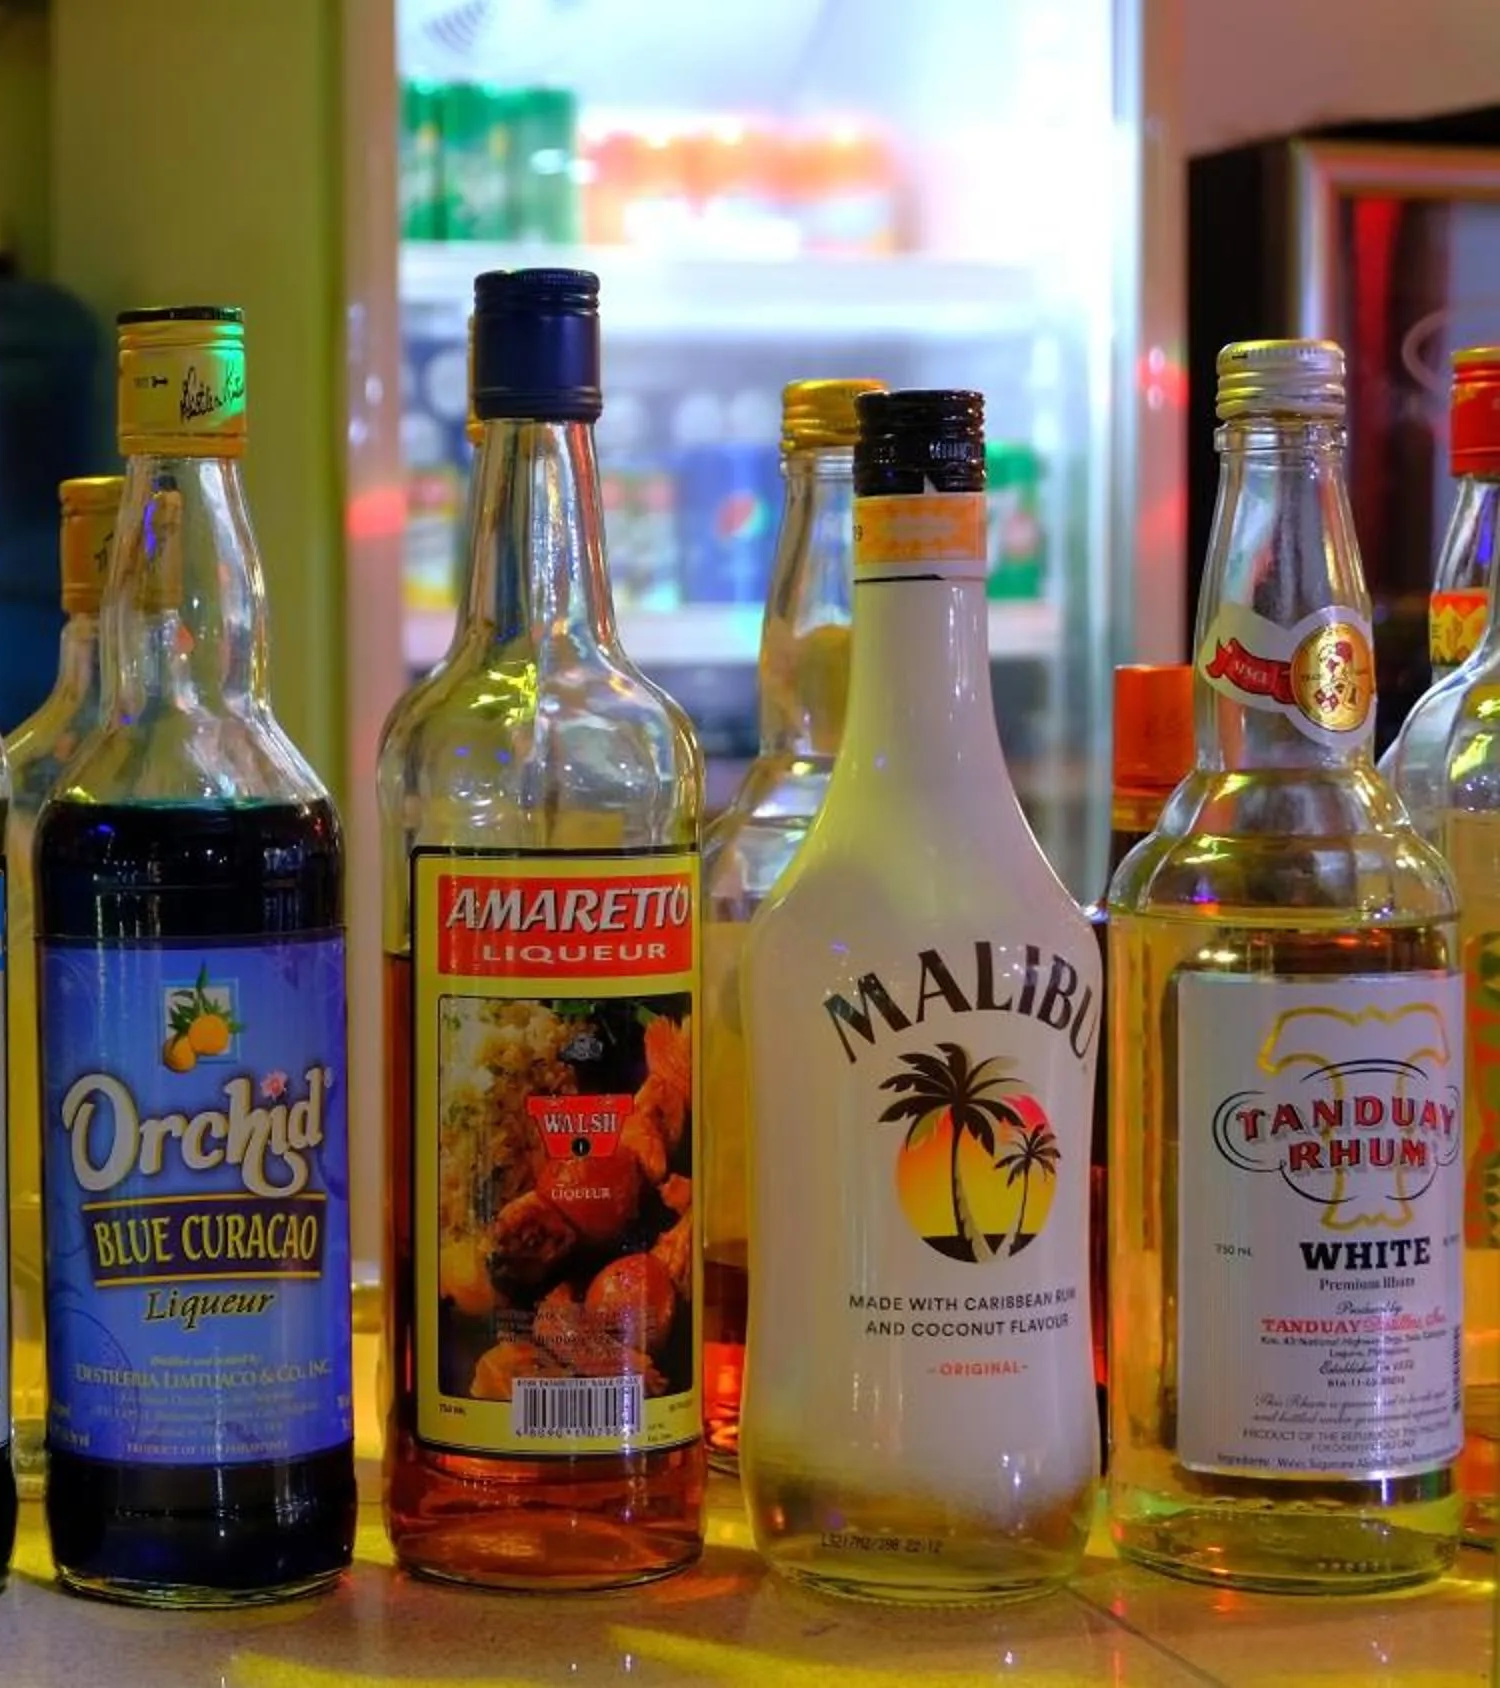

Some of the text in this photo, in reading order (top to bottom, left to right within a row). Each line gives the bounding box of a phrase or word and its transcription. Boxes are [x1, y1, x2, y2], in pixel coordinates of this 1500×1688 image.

[445, 883, 690, 934] AMARETTO
[482, 943, 668, 965] LIQUEUR
[61, 1066, 324, 1199] Orchid
[542, 1112, 618, 1135] WALSH
[1235, 1095, 1455, 1143] TANDUAY
[1287, 1136, 1431, 1174] RHUM
[93, 1212, 319, 1268] BLUE CURACAO
[1299, 1236, 1432, 1272] WHITE
[142, 1288, 276, 1331] Liqueur
[849, 1294, 904, 1312] MADE
[908, 1296, 959, 1312] WITH
[963, 1292, 1052, 1312] CARIBBEAN
[865, 1313, 1070, 1338] AND COCONUT FLAVOUR
[1260, 1317, 1363, 1334] TANDUAY
